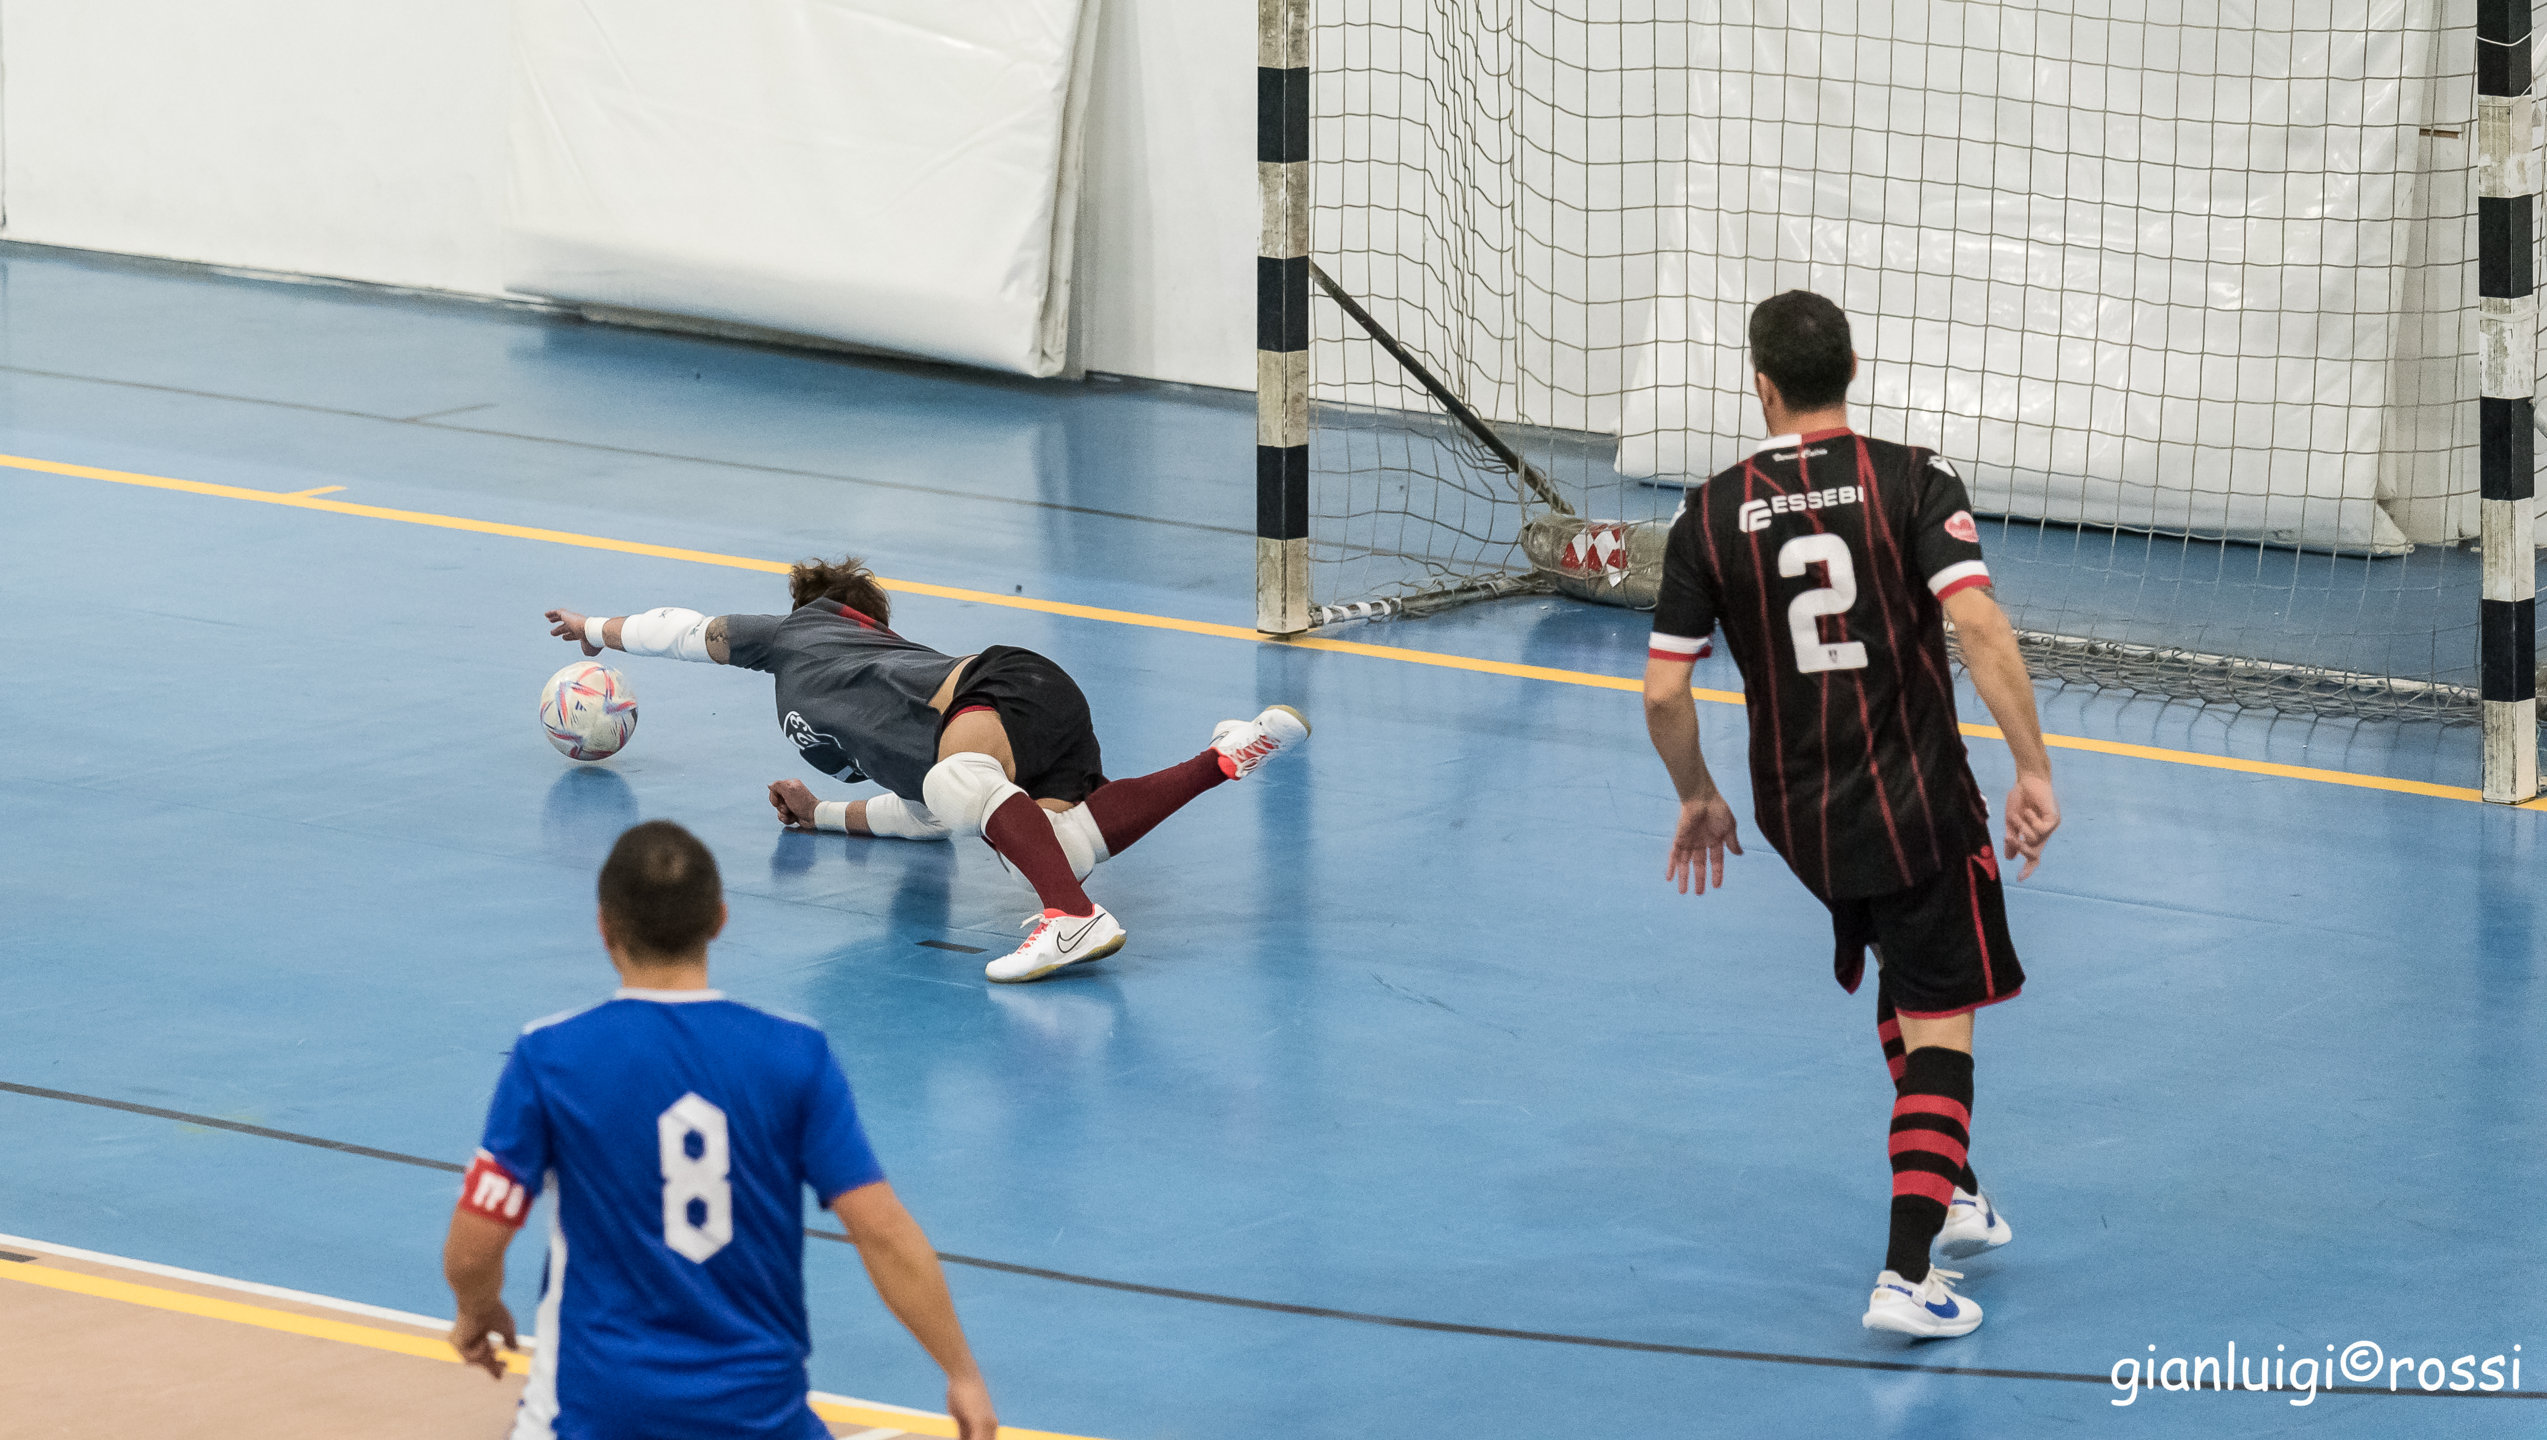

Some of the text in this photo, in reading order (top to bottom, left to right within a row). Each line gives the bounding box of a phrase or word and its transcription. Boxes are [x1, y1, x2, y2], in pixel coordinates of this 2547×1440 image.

[1771, 485, 1864, 514] ESSEBI
[1778, 532, 1868, 674] 2
[657, 1091, 733, 1264] 8
